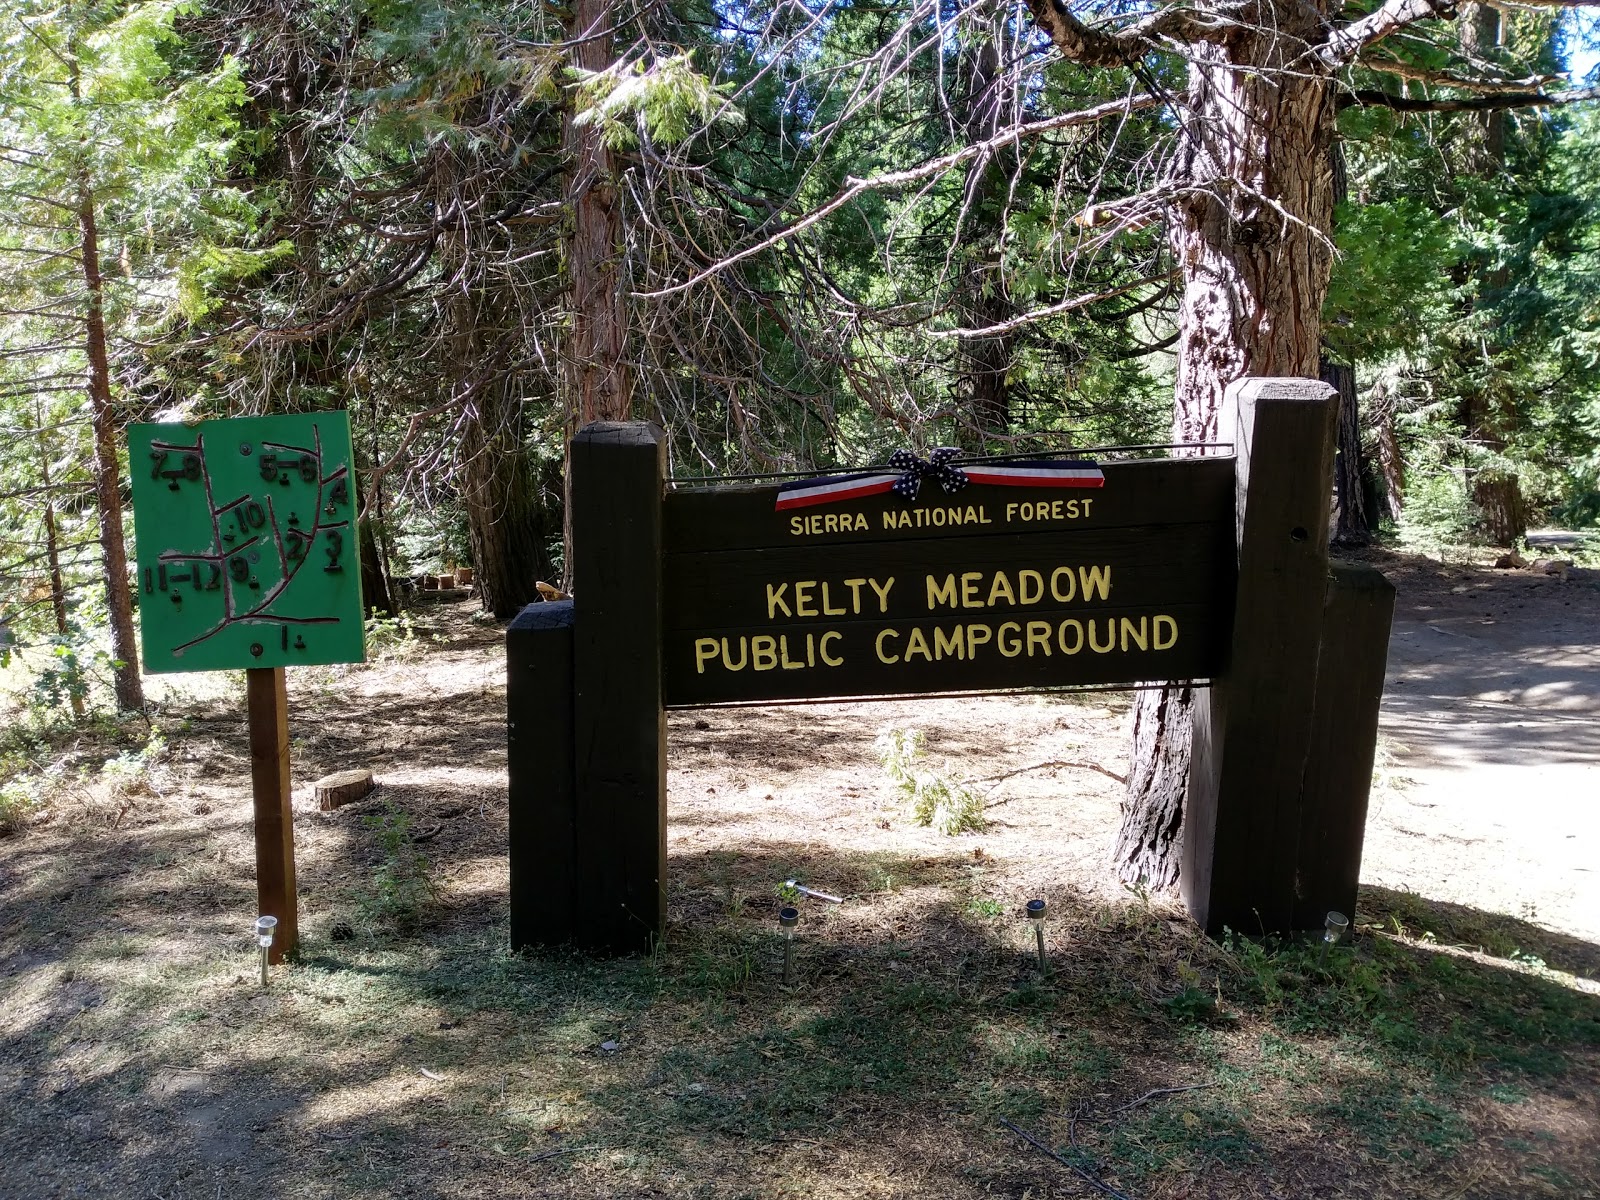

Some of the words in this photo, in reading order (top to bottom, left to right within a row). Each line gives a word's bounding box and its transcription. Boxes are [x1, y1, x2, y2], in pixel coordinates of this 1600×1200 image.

[259, 454, 318, 482] 5-6
[329, 477, 347, 501] 4
[235, 500, 265, 533] 10
[790, 515, 869, 535] SIERRA
[882, 505, 992, 529] NATIONAL
[1006, 498, 1093, 522] FOREST
[286, 531, 303, 559] 2
[325, 529, 343, 559] 3
[230, 556, 249, 583] 9
[766, 576, 895, 619] KELTY
[926, 565, 1111, 609] MEADOW
[281, 625, 288, 651] 1
[694, 631, 845, 673] PUBLIC
[875, 614, 1179, 664] CAMPGROUND
